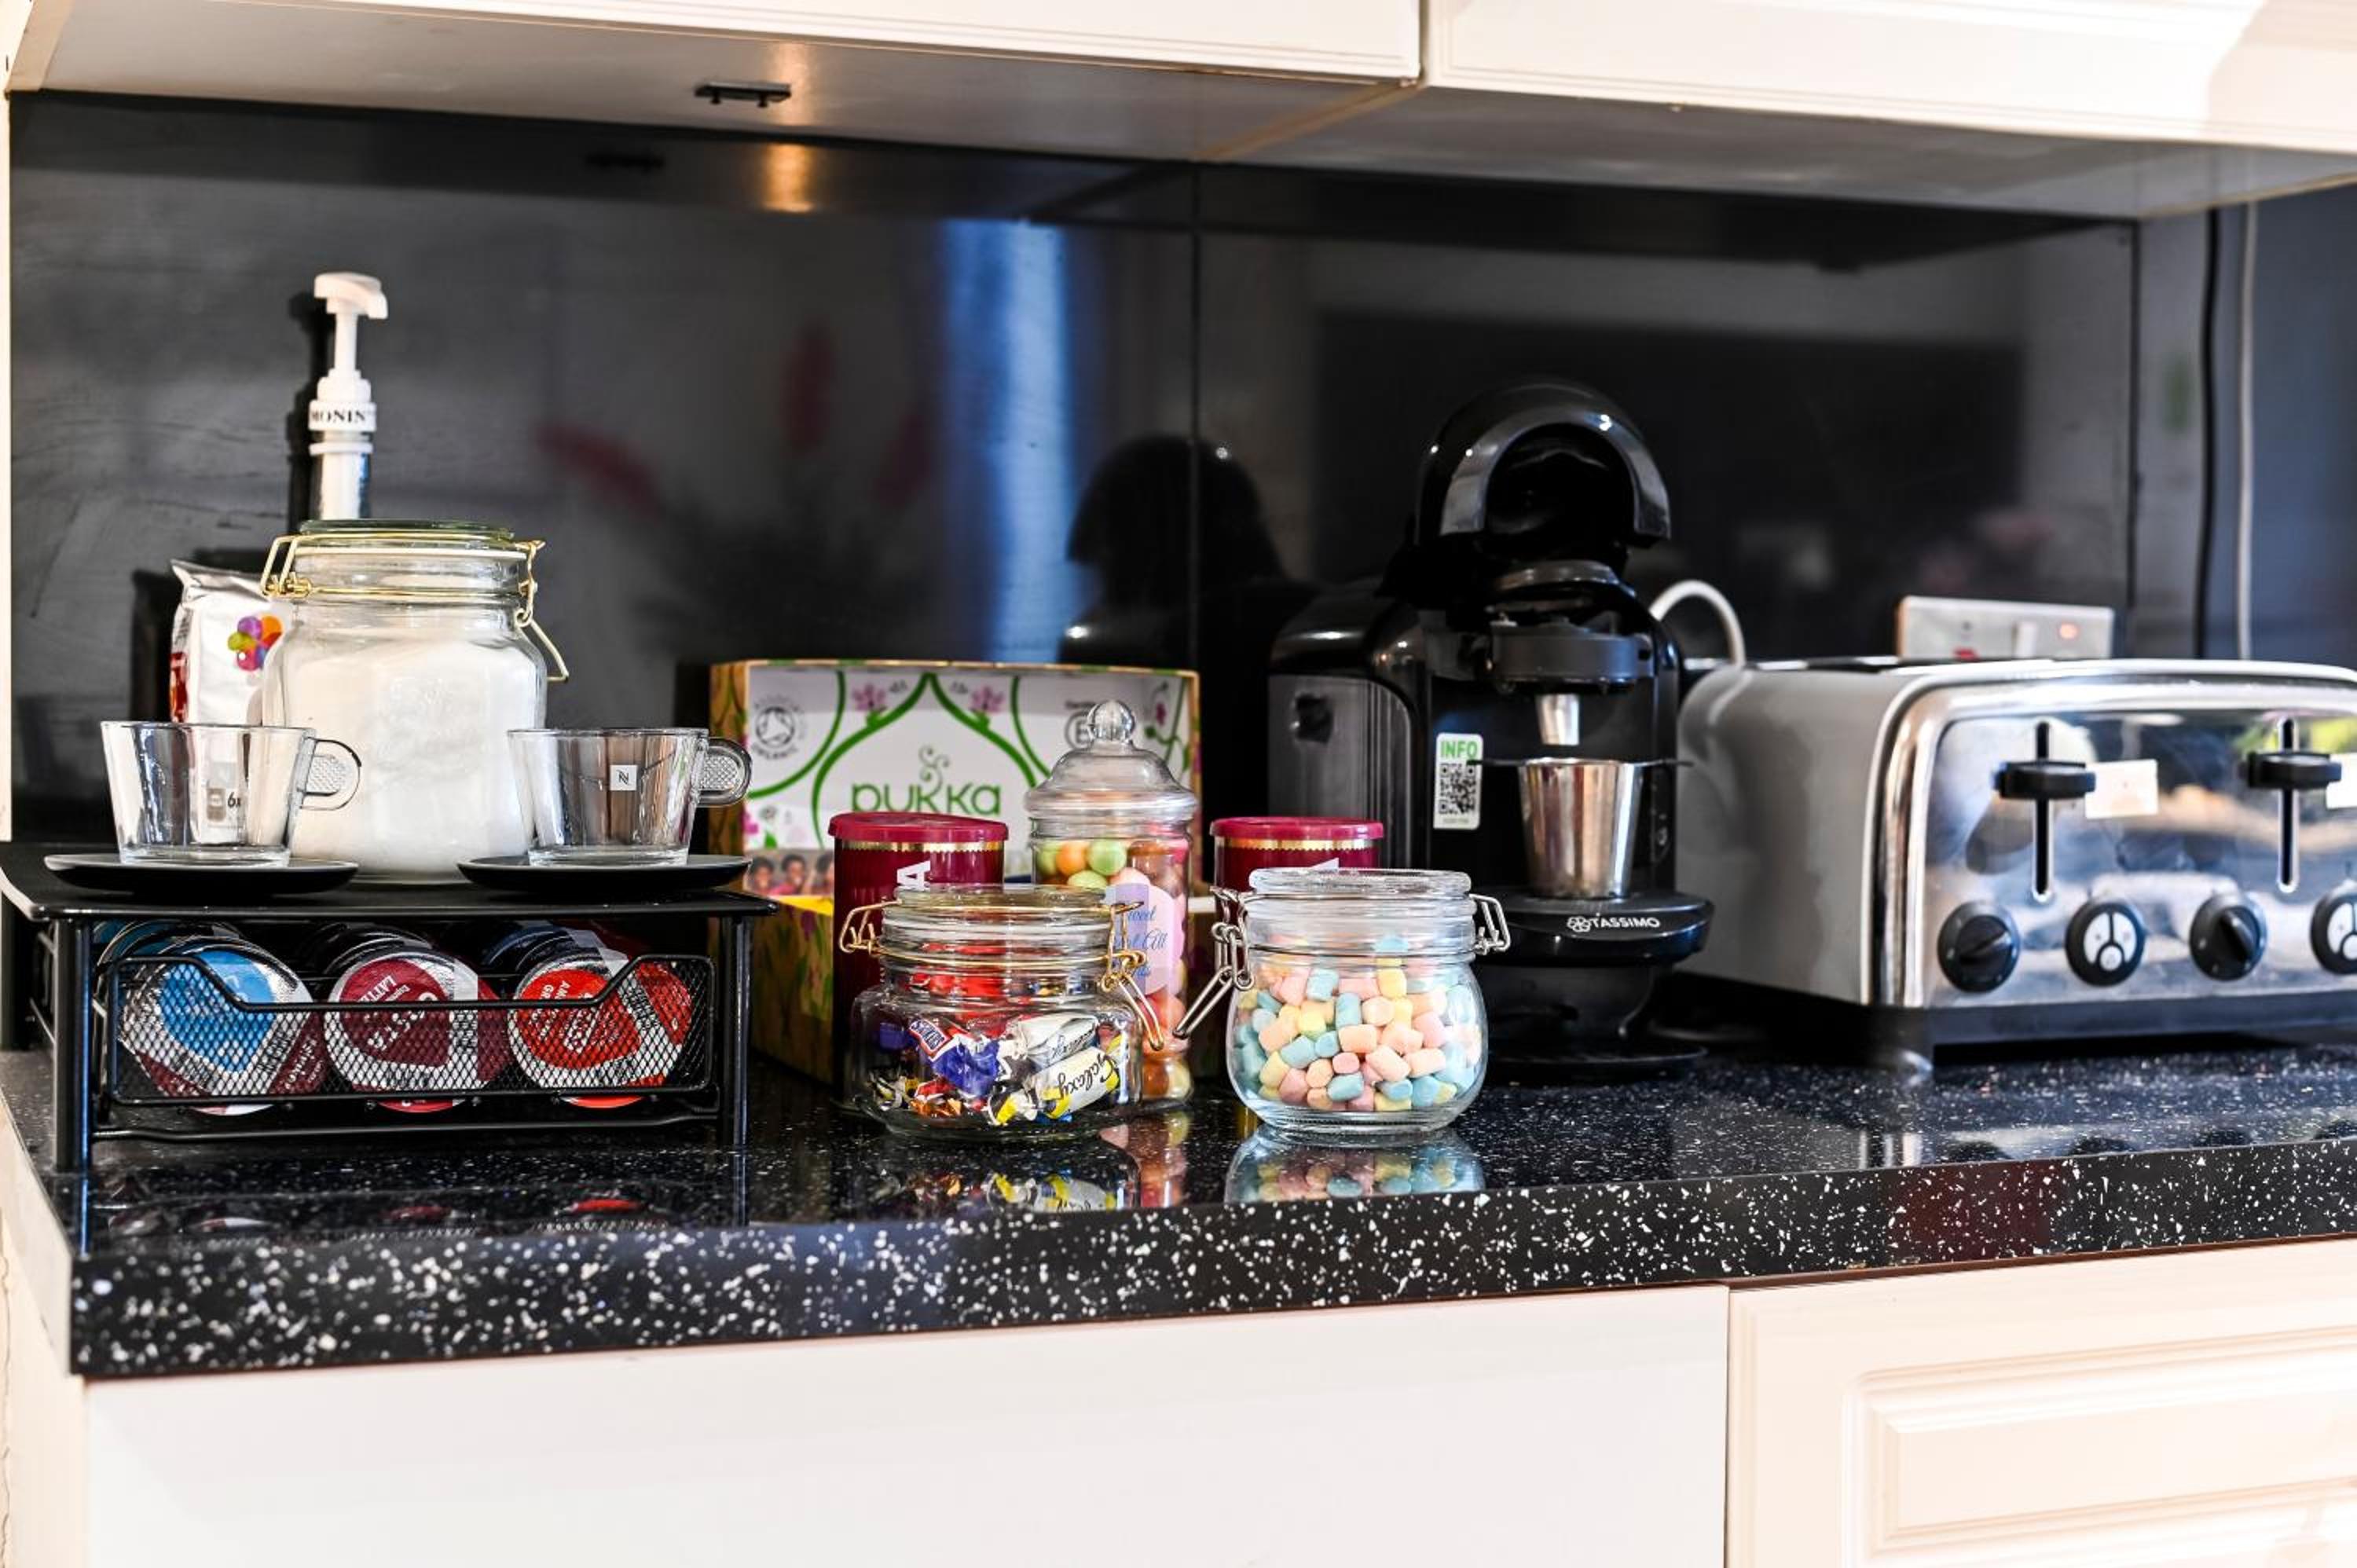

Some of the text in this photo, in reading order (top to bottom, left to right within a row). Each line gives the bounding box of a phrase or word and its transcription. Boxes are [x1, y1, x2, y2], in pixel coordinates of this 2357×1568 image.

[1440, 741, 1478, 760] INFO
[1589, 916, 1661, 928] TASSIMO
[1058, 1053, 1114, 1098] Galaxy
